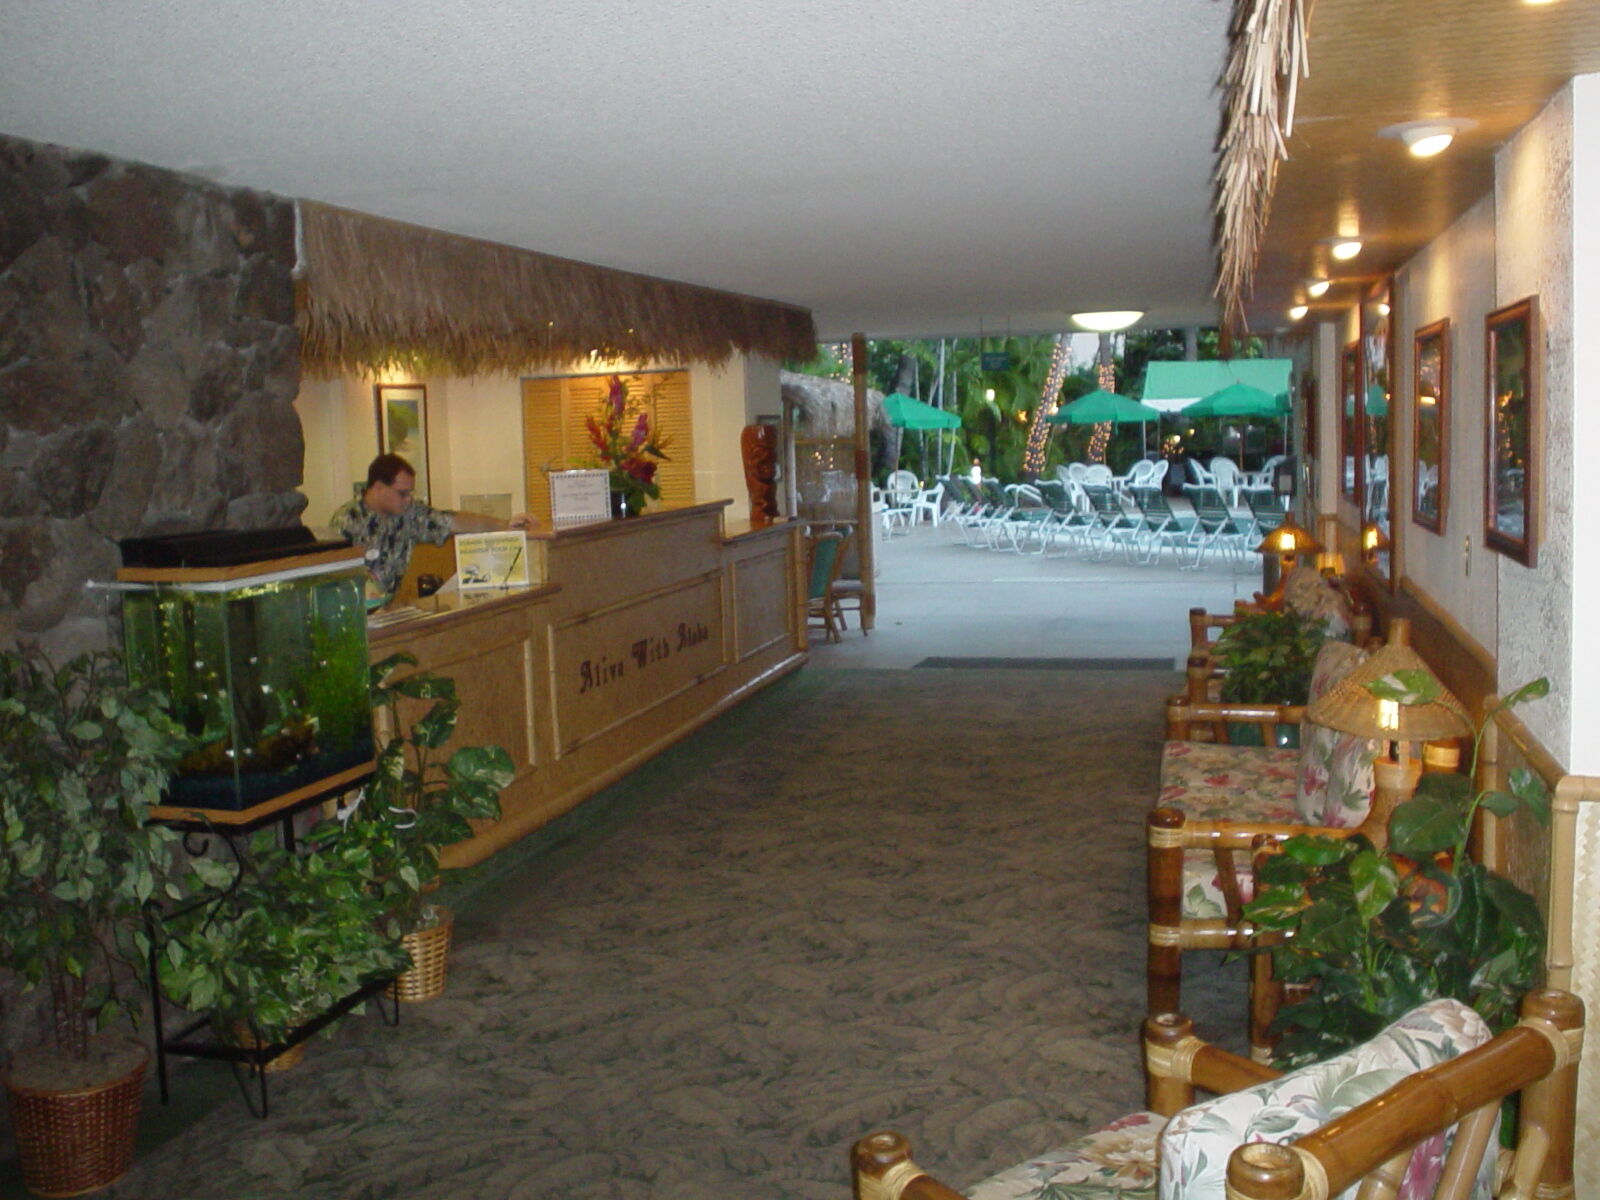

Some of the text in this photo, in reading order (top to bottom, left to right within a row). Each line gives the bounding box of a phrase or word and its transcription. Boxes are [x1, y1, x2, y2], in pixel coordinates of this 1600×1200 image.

[580, 622, 708, 694] Alive With Aloha
